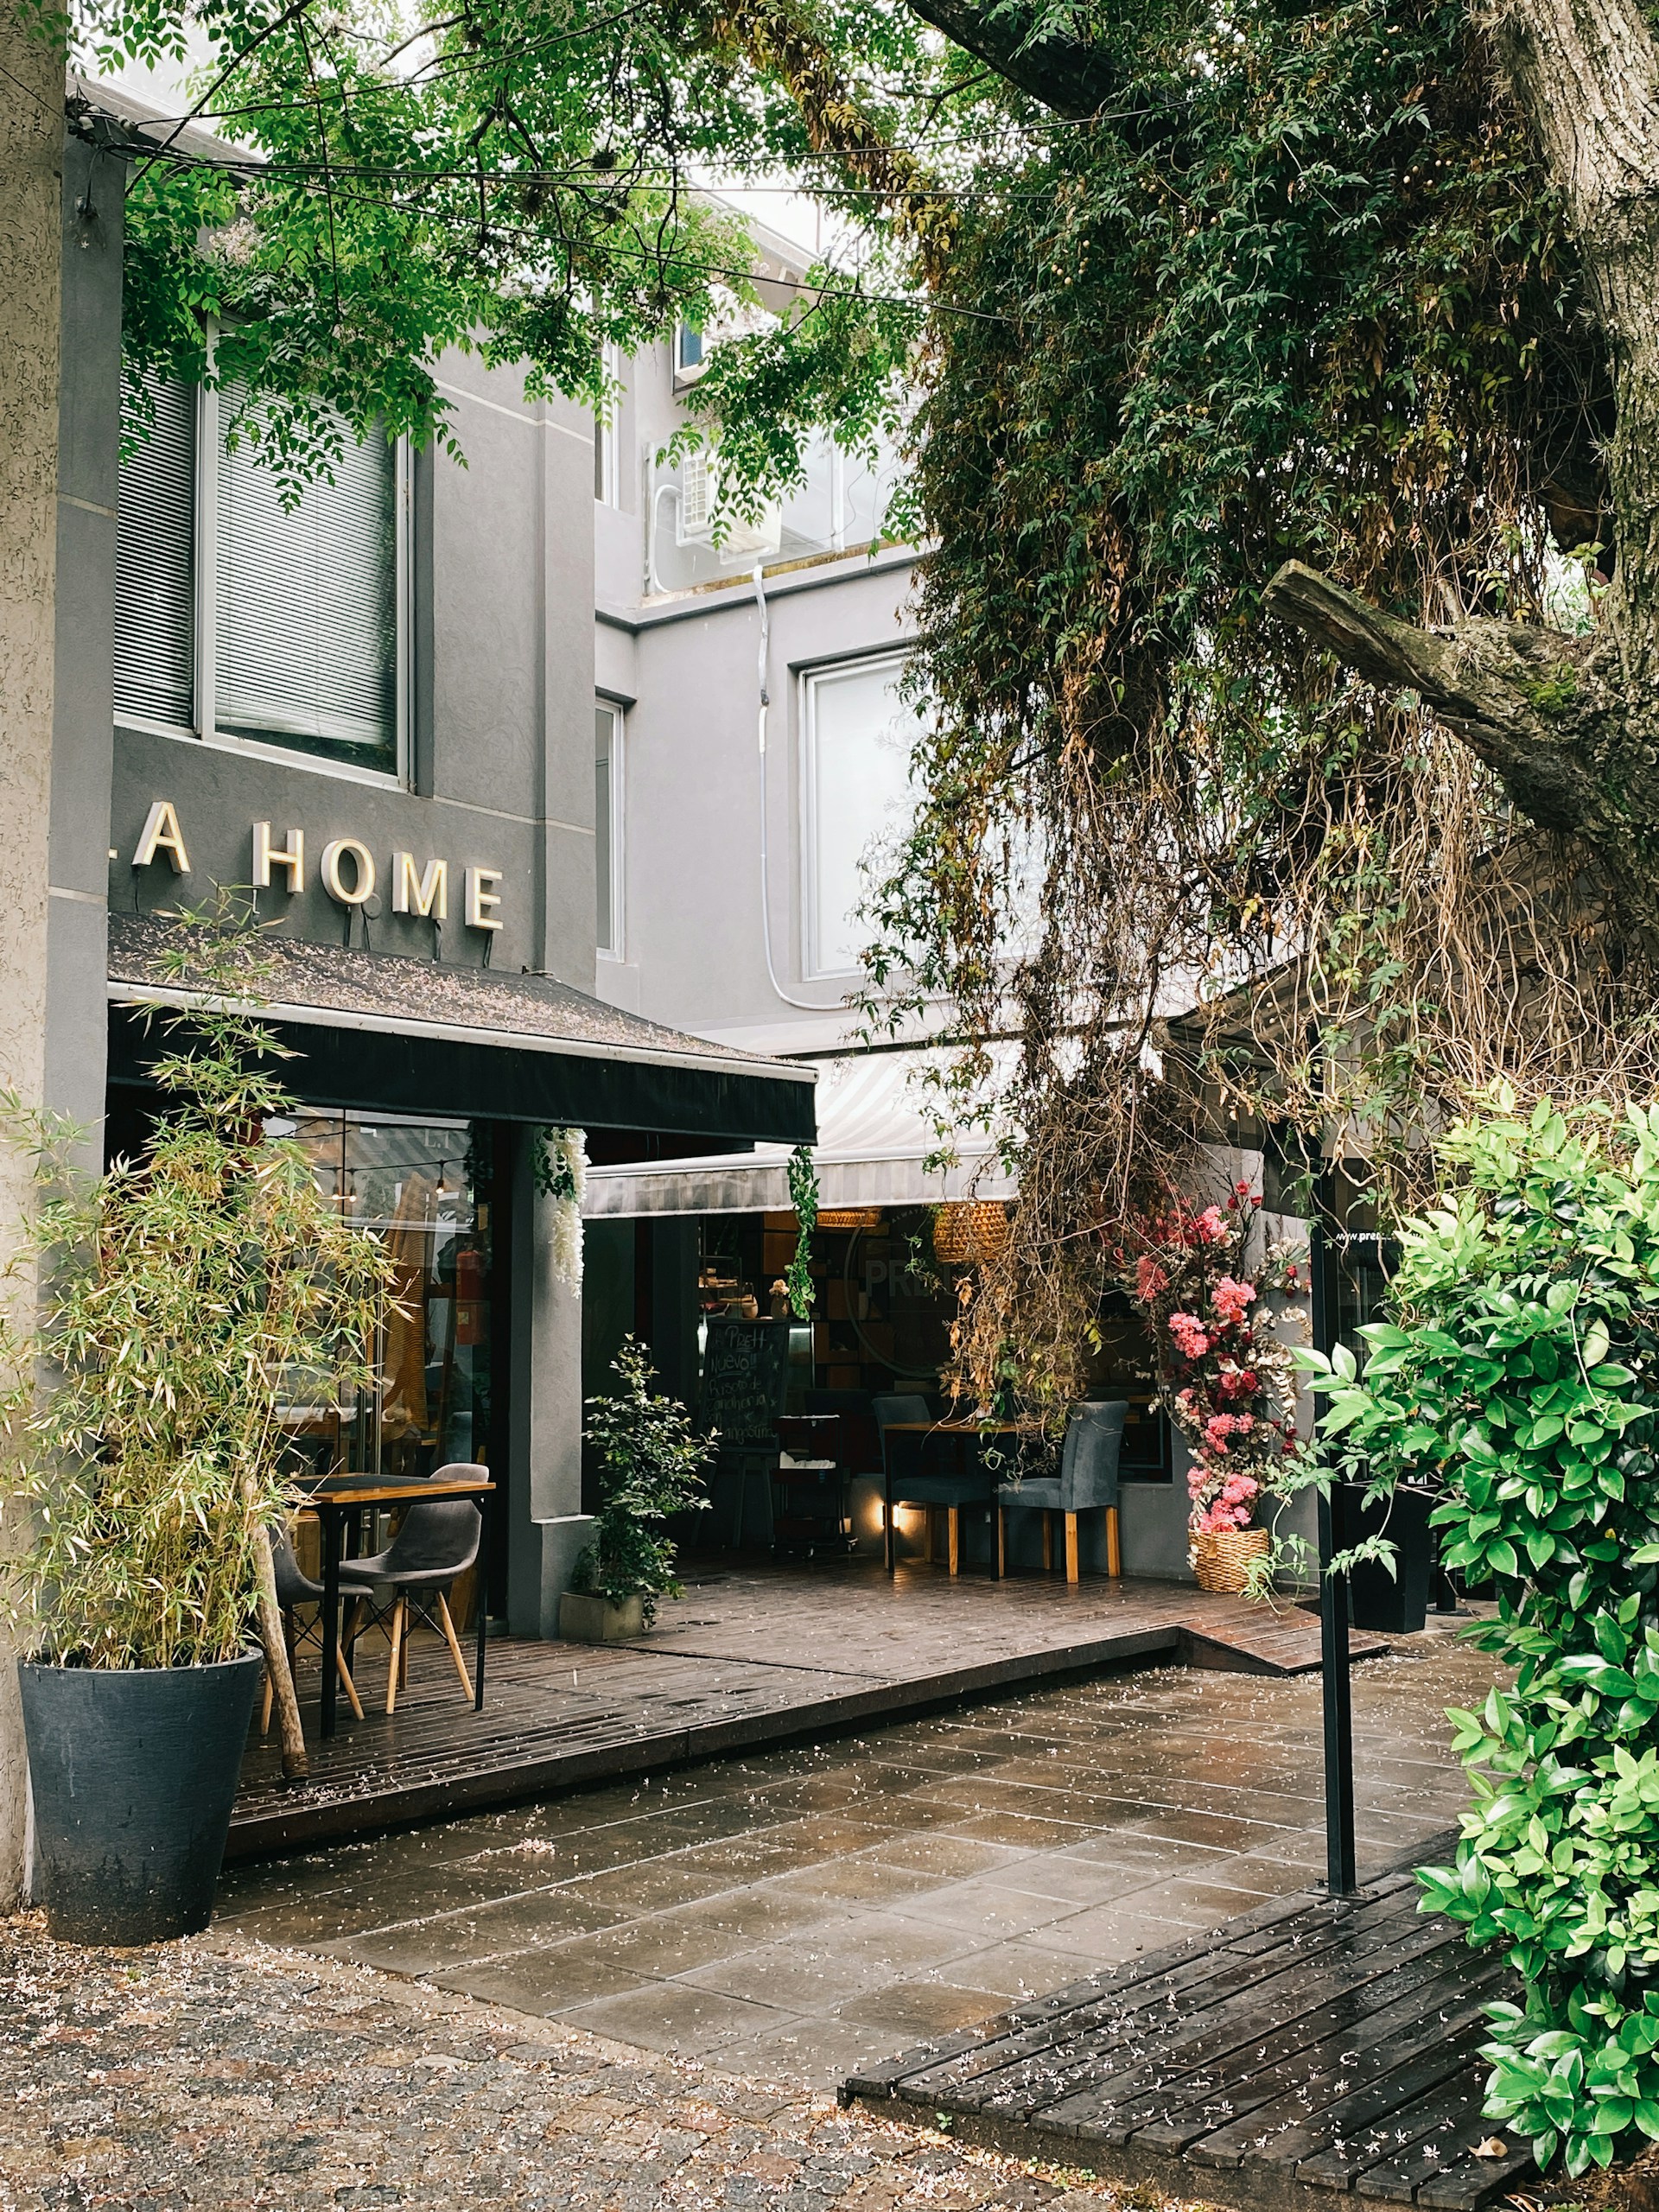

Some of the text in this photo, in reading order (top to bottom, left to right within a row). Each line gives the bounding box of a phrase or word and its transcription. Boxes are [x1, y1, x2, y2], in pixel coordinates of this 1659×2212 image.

[109, 801, 504, 930] A HOME
[750, 1376, 761, 1390] de
